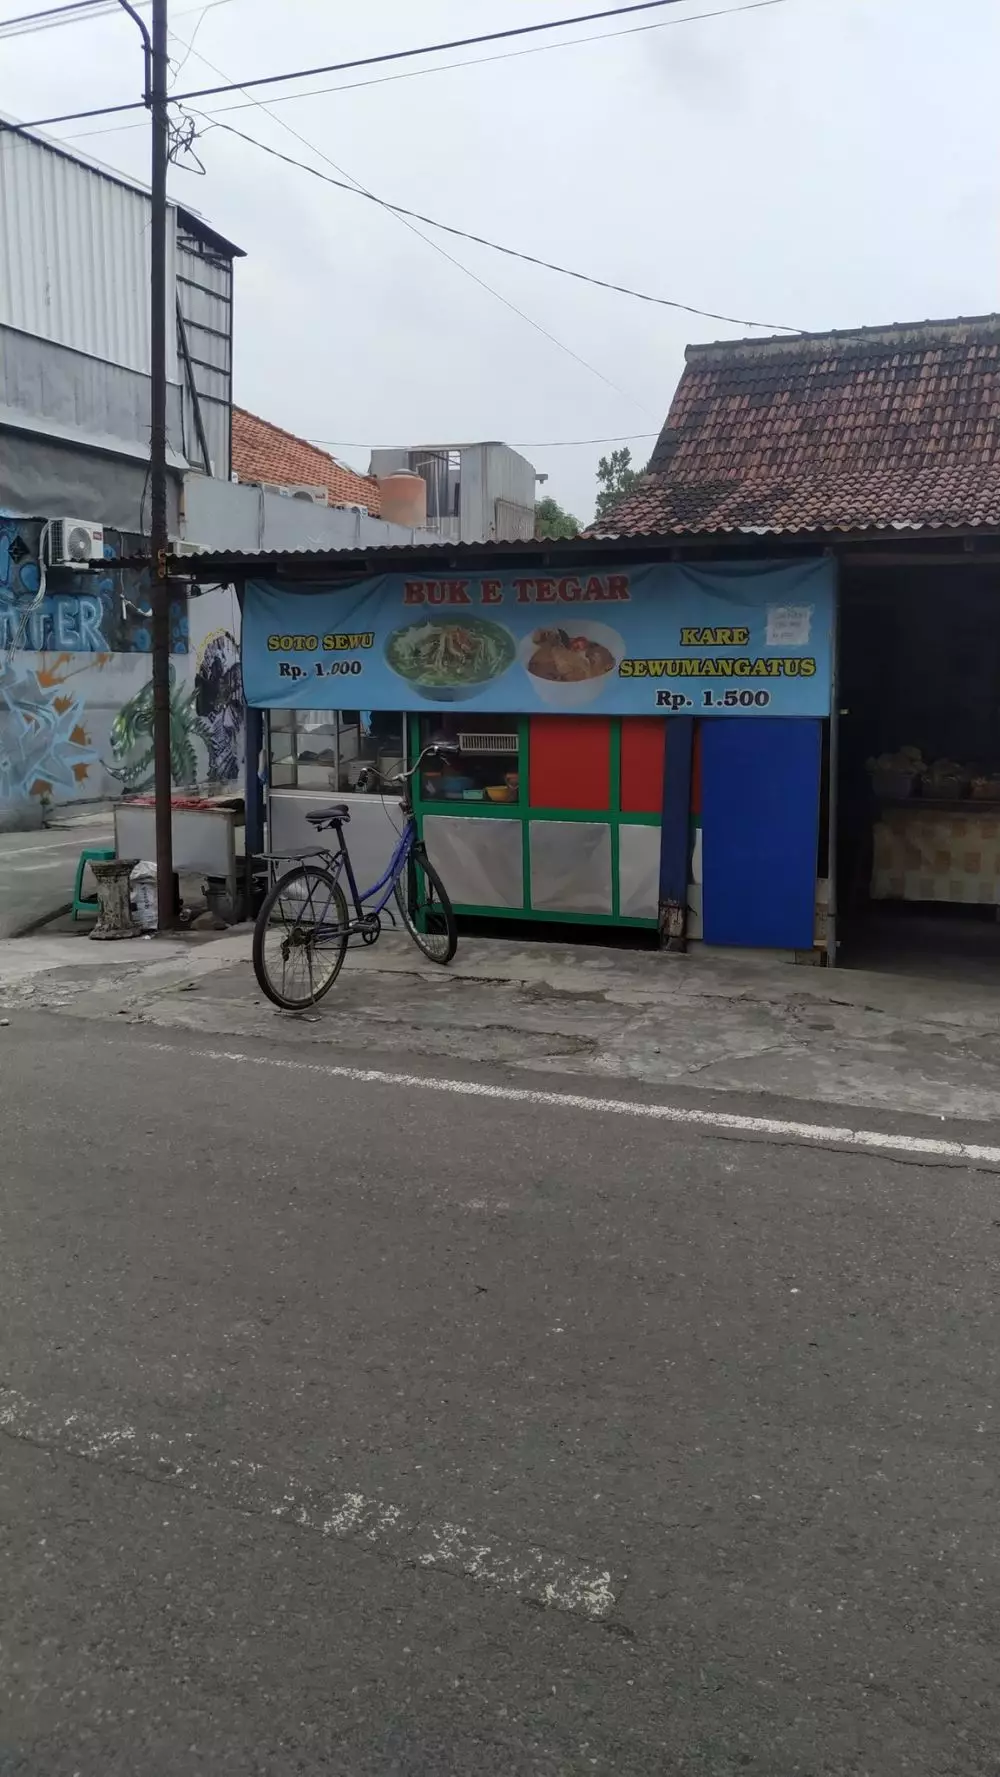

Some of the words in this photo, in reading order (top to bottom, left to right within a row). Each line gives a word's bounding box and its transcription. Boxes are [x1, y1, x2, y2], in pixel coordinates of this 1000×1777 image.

[404, 580, 472, 604] BUK
[481, 580, 503, 604] E
[516, 576, 631, 604] TEGAR
[267, 634, 318, 652] SOTO
[322, 632, 375, 651] SEWU
[680, 628, 749, 646] KARE
[279, 662, 307, 680] Rp.
[315, 660, 362, 676] 1.000
[619, 658, 816, 677] SEWUMANGATUS
[656, 690, 692, 711] Rp.
[703, 690, 770, 707] 1.500
